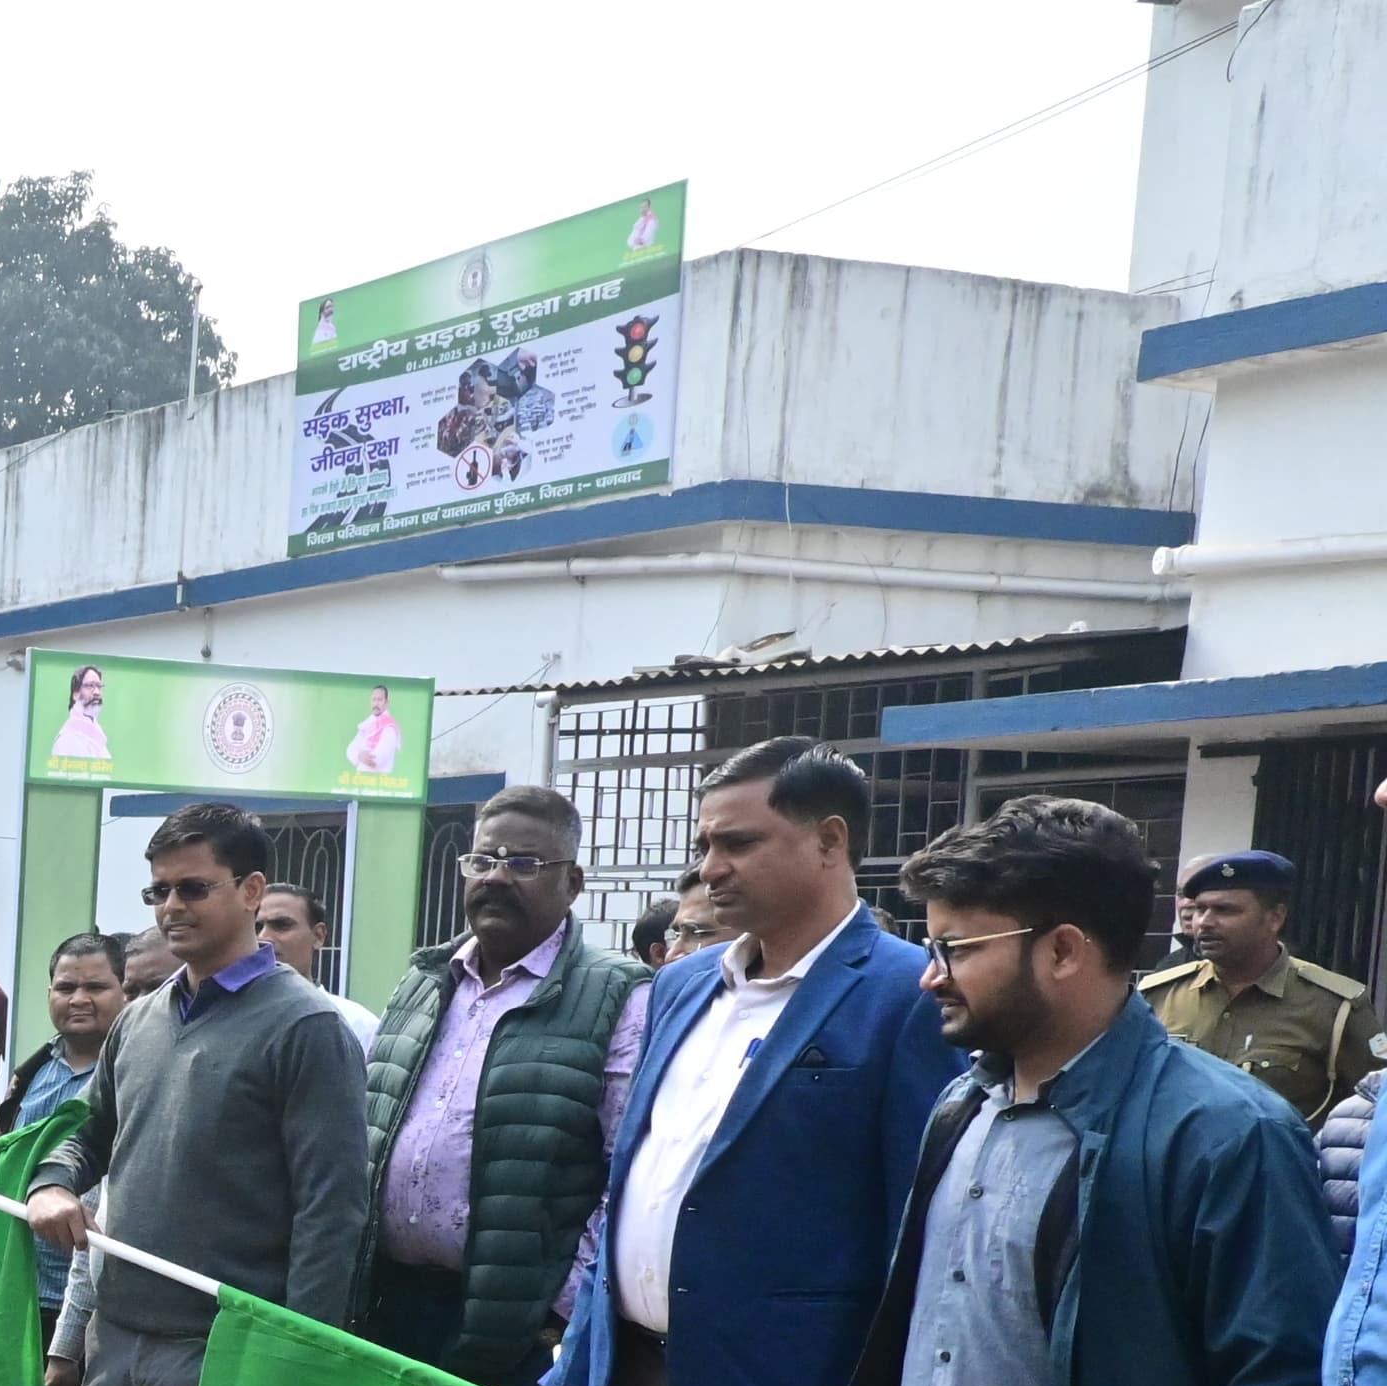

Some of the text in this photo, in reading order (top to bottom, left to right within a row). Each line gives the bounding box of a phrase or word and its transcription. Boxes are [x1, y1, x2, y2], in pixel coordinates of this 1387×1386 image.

[338, 339, 409, 372] राष्ट्रीय
[415, 318, 483, 349] सड़क
[490, 296, 561, 336] सुरक्षा
[569, 278, 624, 306] माह
[406, 348, 462, 372] 01.01.2025
[480, 327, 539, 351] 31.01.2025
[303, 396, 410, 438] सड़क सुरक्षा,
[310, 442, 362, 473] जीवन
[366, 437, 400, 460] रक्षा
[307, 531, 334, 547] जिला
[338, 522, 380, 540] परिवहन
[383, 514, 419, 530] विभाग
[422, 507, 440, 524] एवं
[442, 501, 490, 520] यातायात
[494, 488, 534, 513] पुलिस,
[539, 482, 573, 501] जिला
[596, 469, 642, 488] धनबाद
